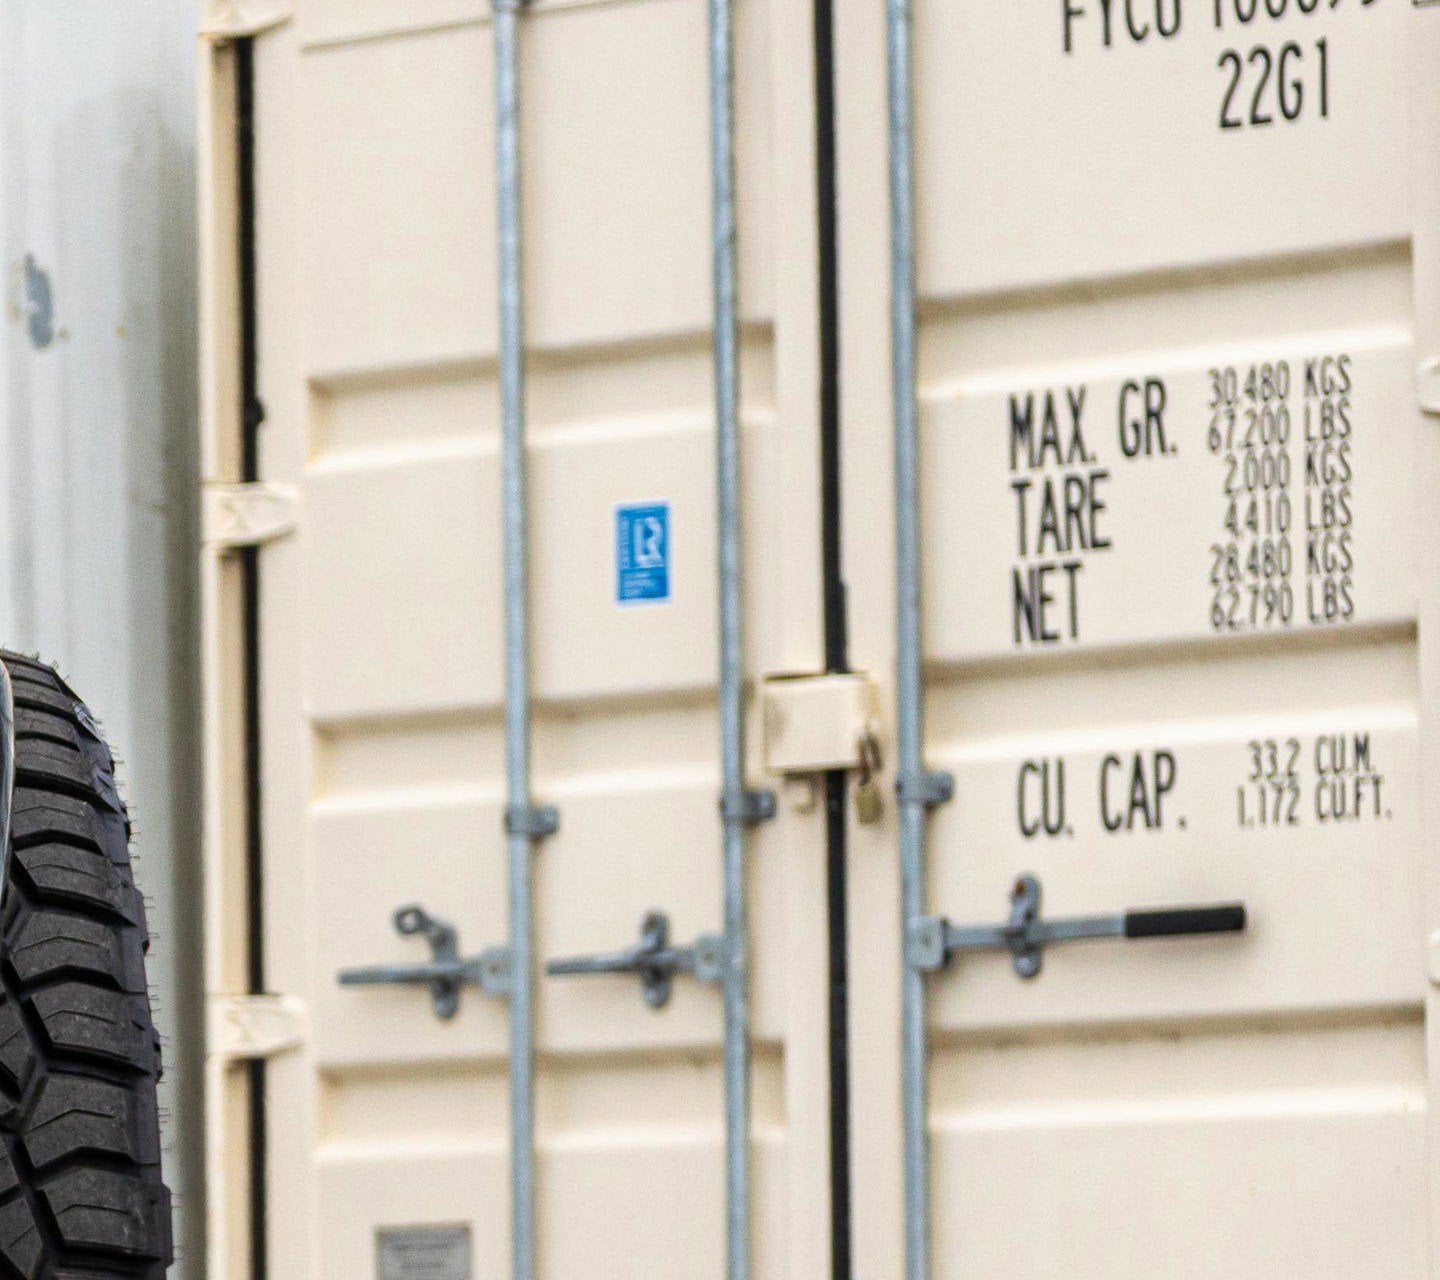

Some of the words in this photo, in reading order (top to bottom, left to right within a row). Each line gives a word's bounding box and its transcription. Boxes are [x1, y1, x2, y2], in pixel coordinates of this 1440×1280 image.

[1217, 36, 1329, 129] 22G1
[1304, 354, 1351, 397] KGS
[1008, 385, 1097, 471] MAX.
[1118, 376, 1178, 458] GR.
[1304, 397, 1351, 442] LBS
[1304, 442, 1352, 486] KGS
[1011, 470, 1112, 556] TARE
[1305, 486, 1352, 531] LBS
[1306, 531, 1353, 575] KGS
[1011, 563, 1084, 645] NET
[1306, 575, 1354, 622] LBS
[1017, 759, 1073, 838] CU.
[1100, 749, 1187, 832] CAP.
